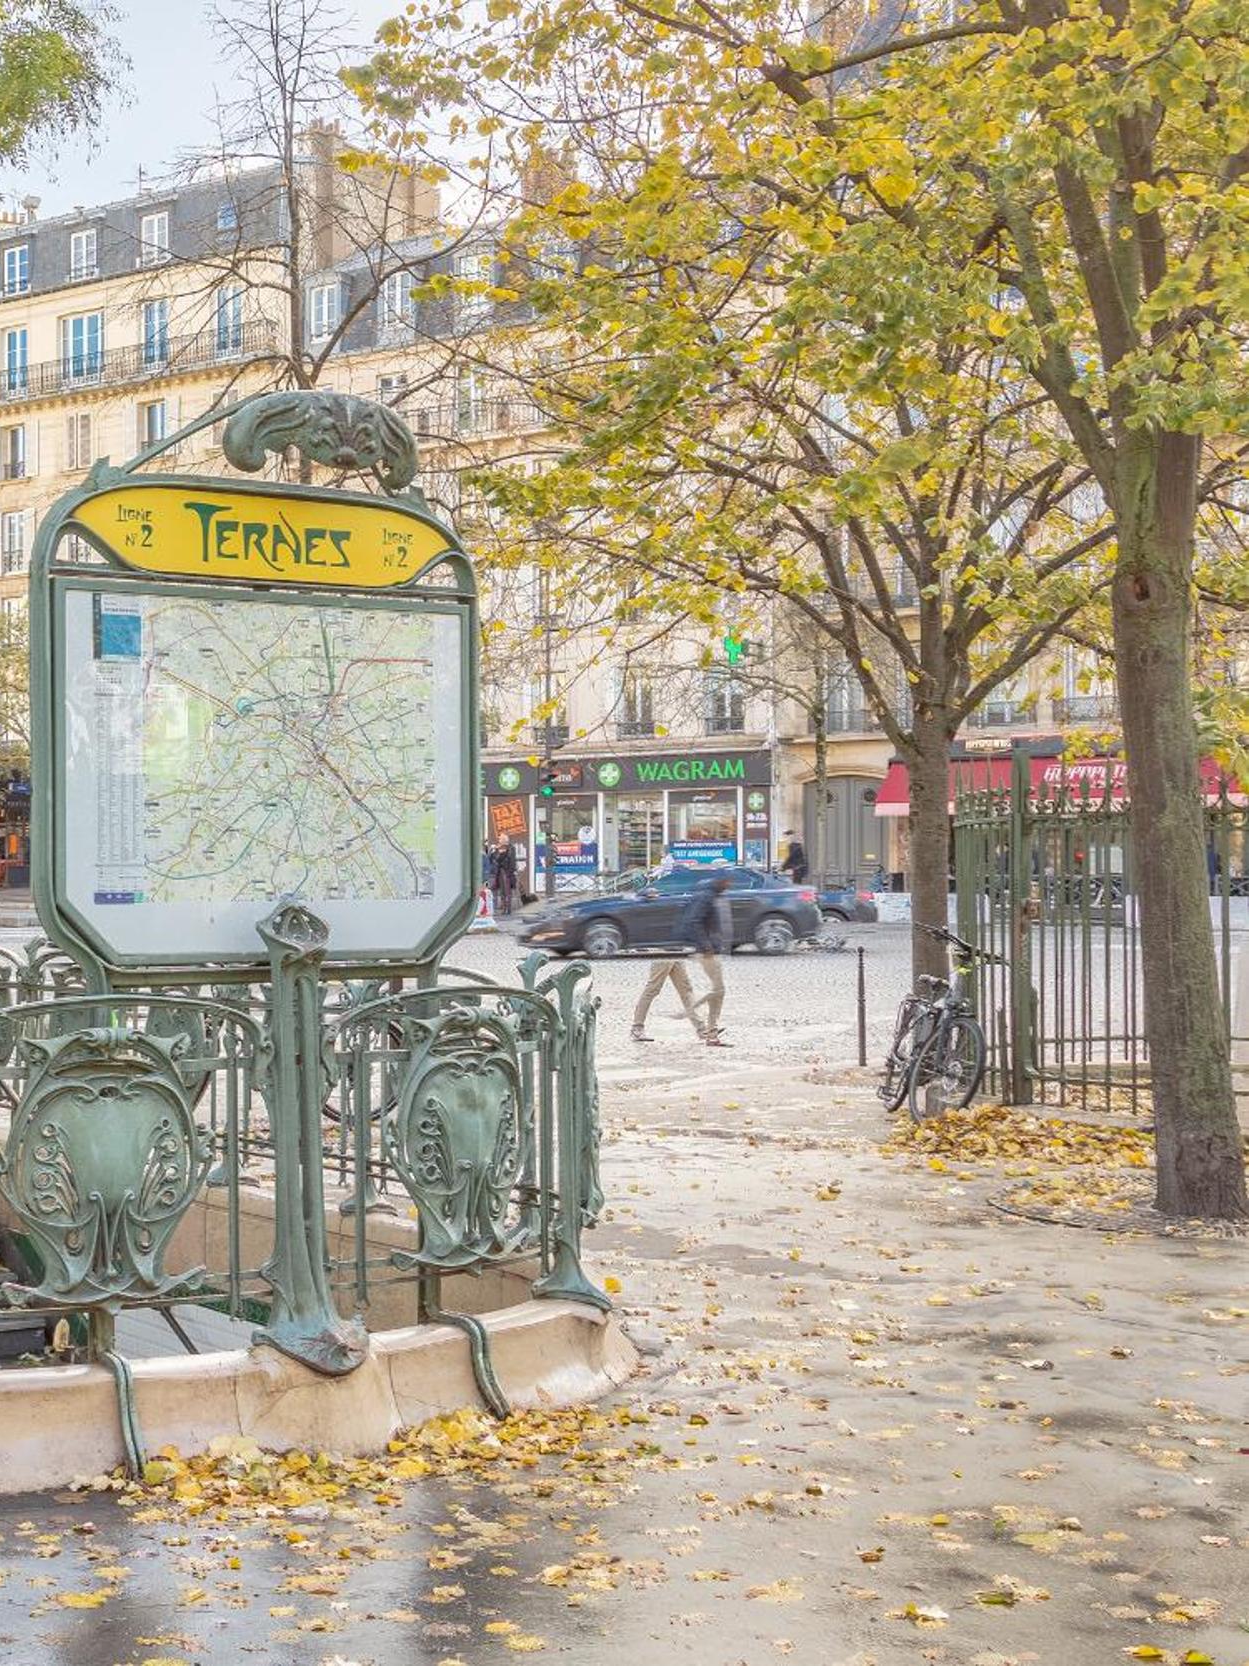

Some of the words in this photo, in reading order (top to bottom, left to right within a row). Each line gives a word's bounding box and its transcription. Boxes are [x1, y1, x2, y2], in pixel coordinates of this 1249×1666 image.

[116, 504, 152, 522] LIGNE
[141, 524, 153, 547] 2
[183, 502, 351, 572] TERNES
[382, 528, 414, 546] LIGNE
[397, 546, 408, 567] 2
[637, 759, 746, 782] WAGRAM
